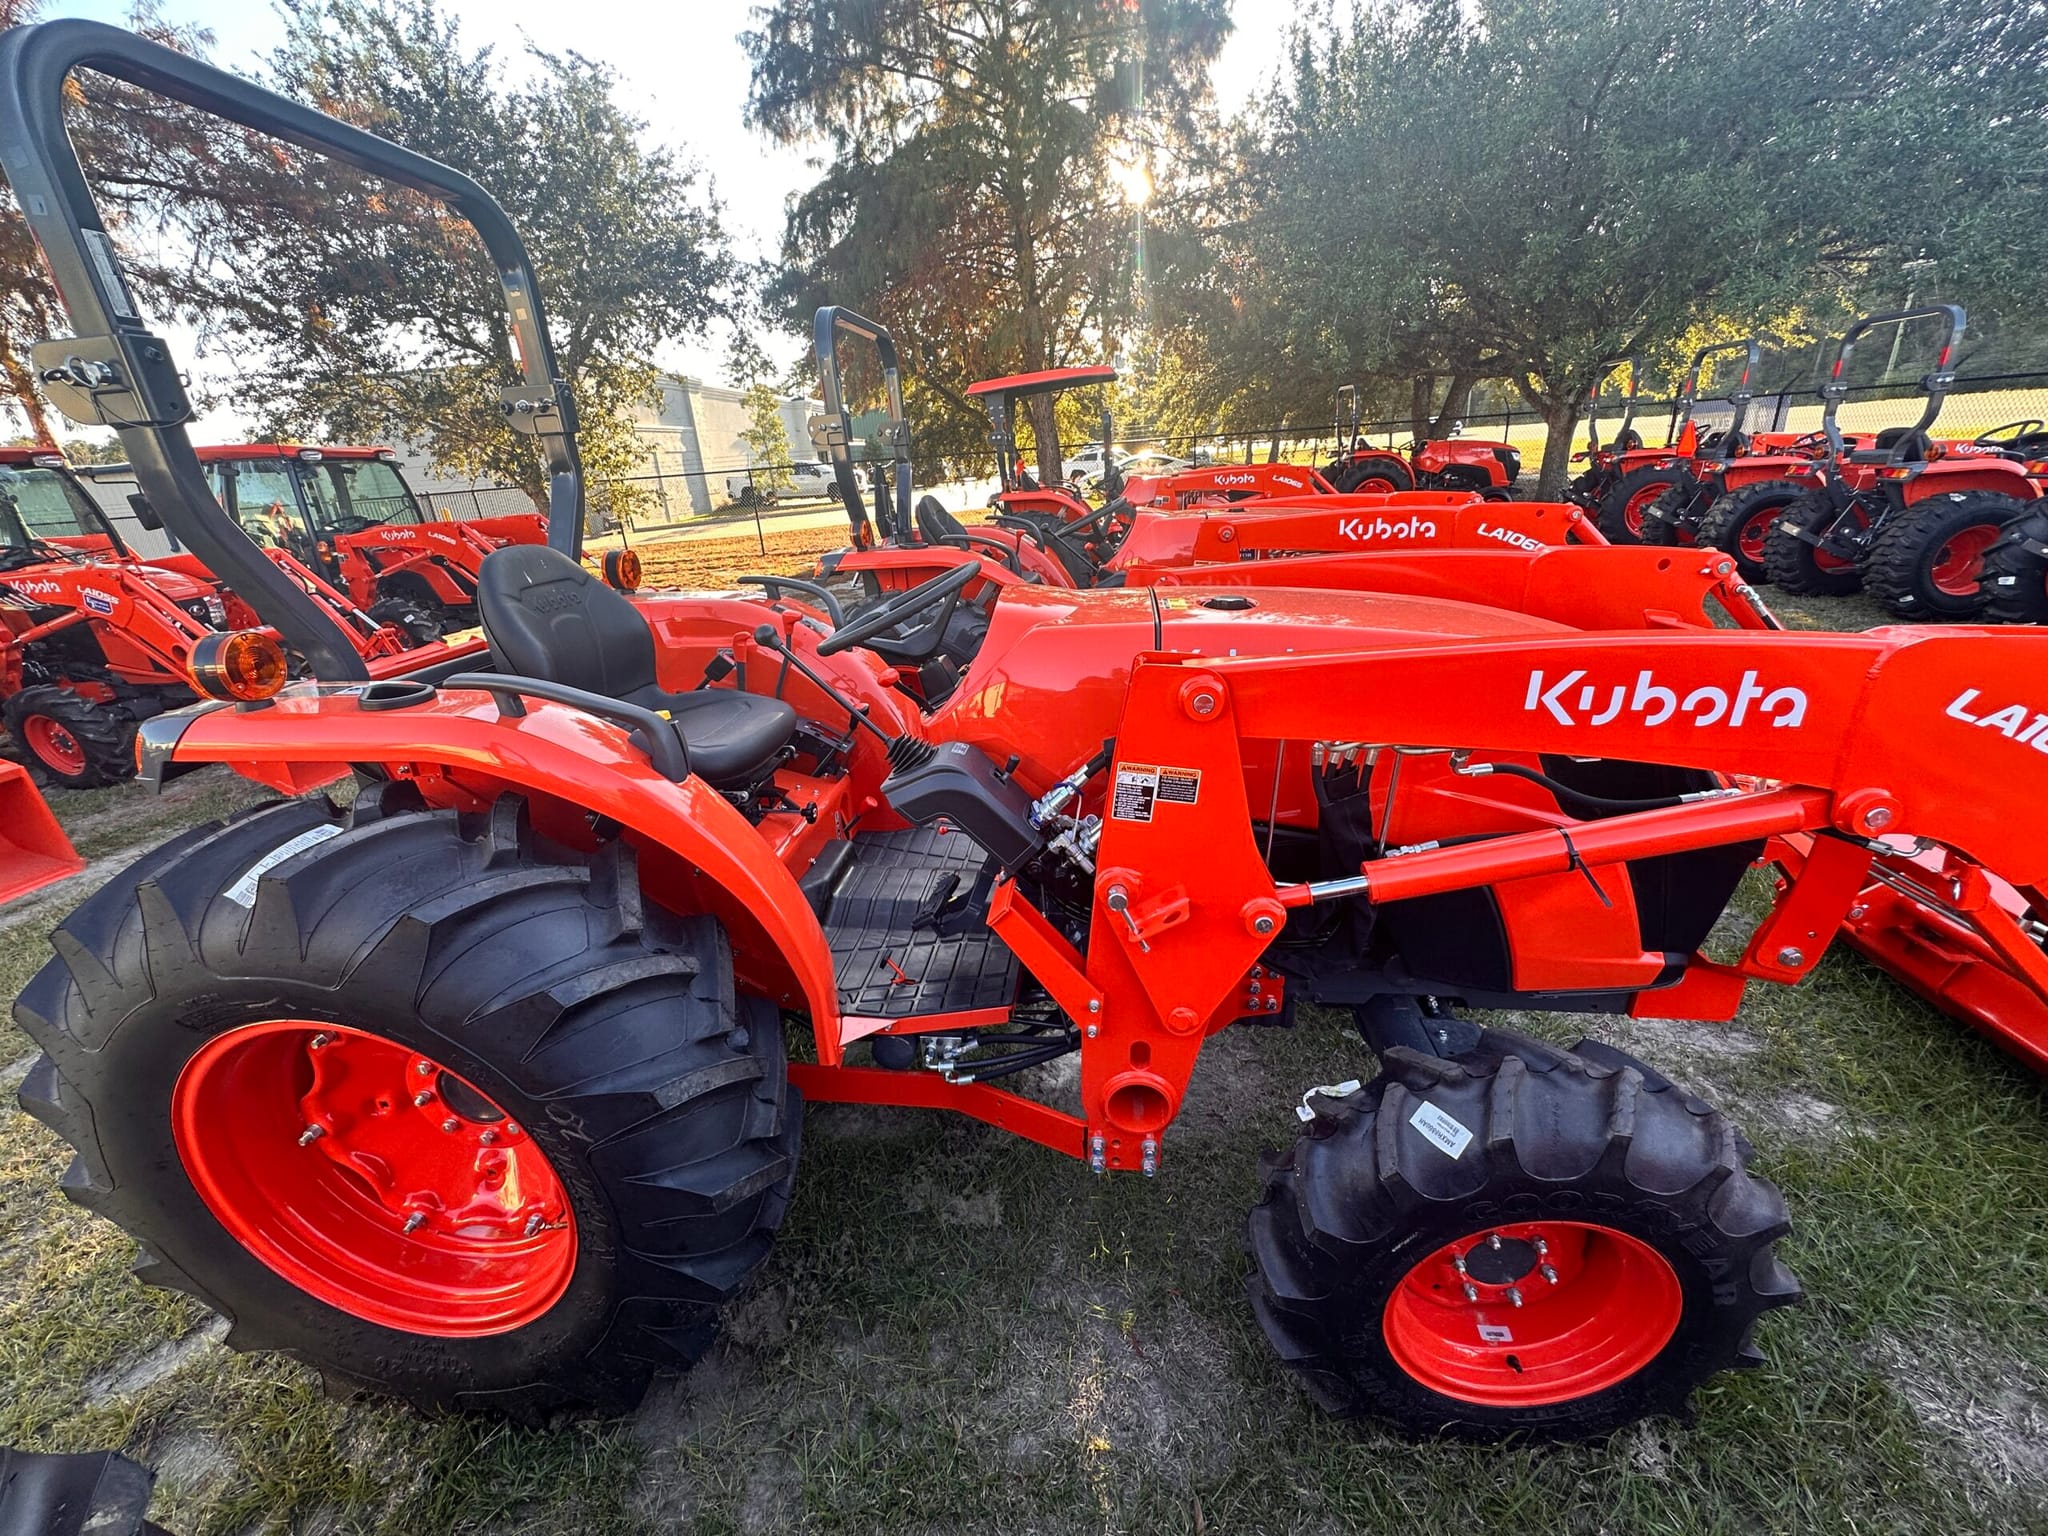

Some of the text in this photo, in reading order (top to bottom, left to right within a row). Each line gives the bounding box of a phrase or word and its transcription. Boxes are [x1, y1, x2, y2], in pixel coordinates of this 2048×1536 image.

[1214, 473, 1255, 485] Kubota
[1338, 515, 1437, 541] Kubota
[380, 529, 416, 541] Kubota
[9, 579, 61, 594] Kubota
[1524, 670, 1807, 727] Kubota
[1126, 765, 1155, 774] WARNING
[1168, 770, 1197, 778] WARNING
